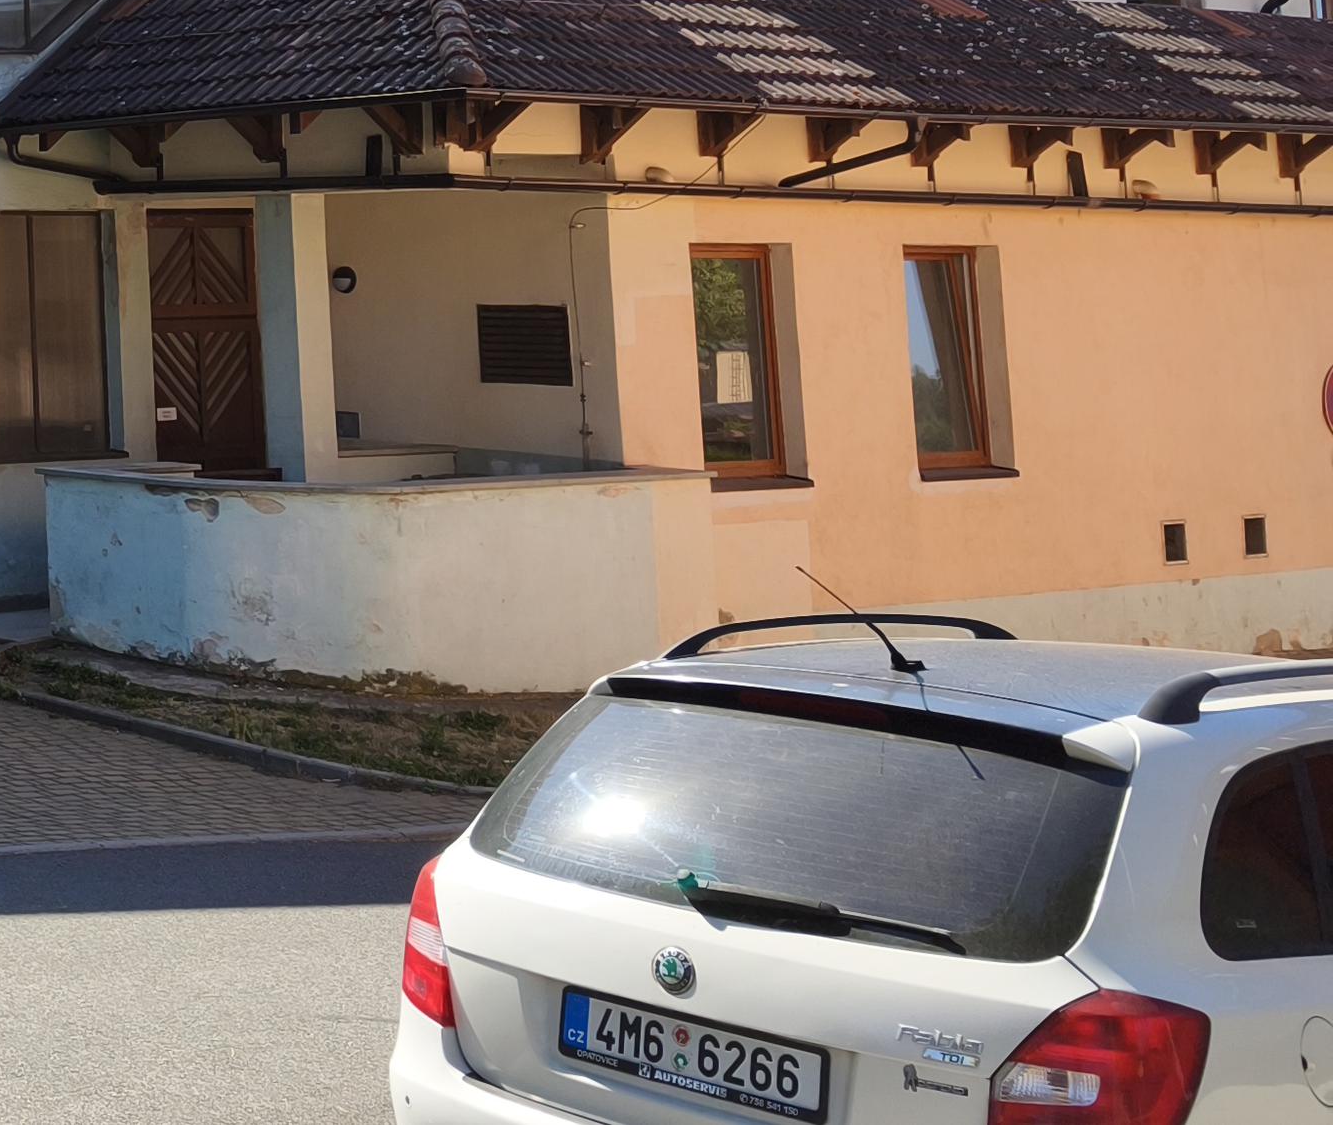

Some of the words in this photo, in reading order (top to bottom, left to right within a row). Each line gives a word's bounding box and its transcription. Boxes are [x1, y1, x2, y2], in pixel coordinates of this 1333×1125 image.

[568, 1029, 584, 1043] CZ
[577, 1049, 619, 1067] OPATOVICE
[596, 1008, 665, 1063] 4M6
[697, 1034, 800, 1099] 6266
[941, 1053, 964, 1064] TDI
[654, 1069, 727, 1099] AUTOSERVIS
